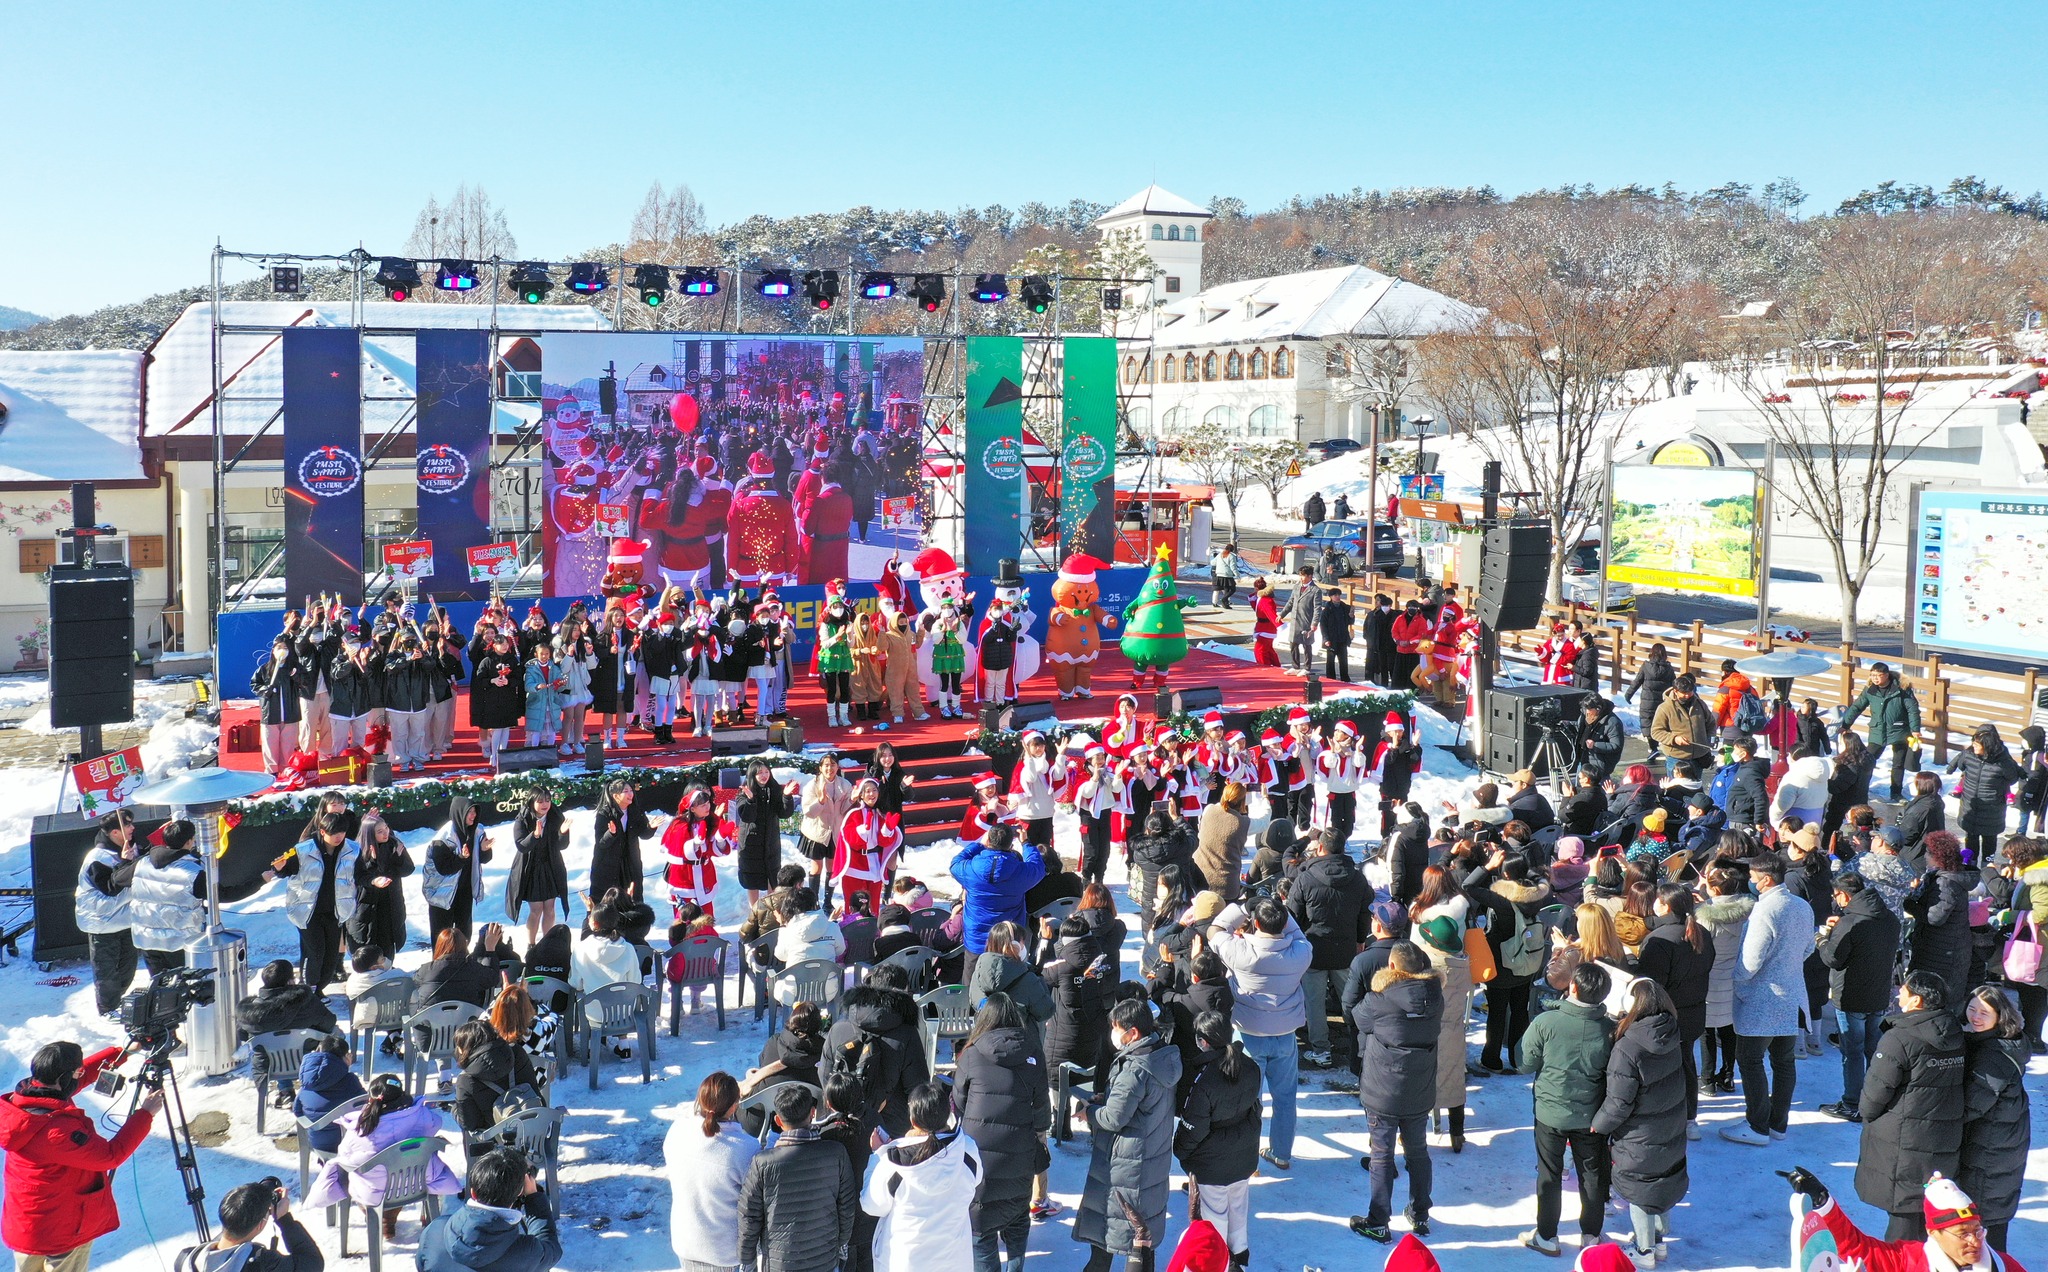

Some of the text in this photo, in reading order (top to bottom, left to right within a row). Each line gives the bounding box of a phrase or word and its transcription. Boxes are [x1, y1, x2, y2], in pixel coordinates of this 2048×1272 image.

[312, 467, 347, 476] SANTA
[422, 465, 456, 474] SANTA
[315, 481, 344, 489] FESTIVAL
[2027, 505, 2048, 515] 관광
